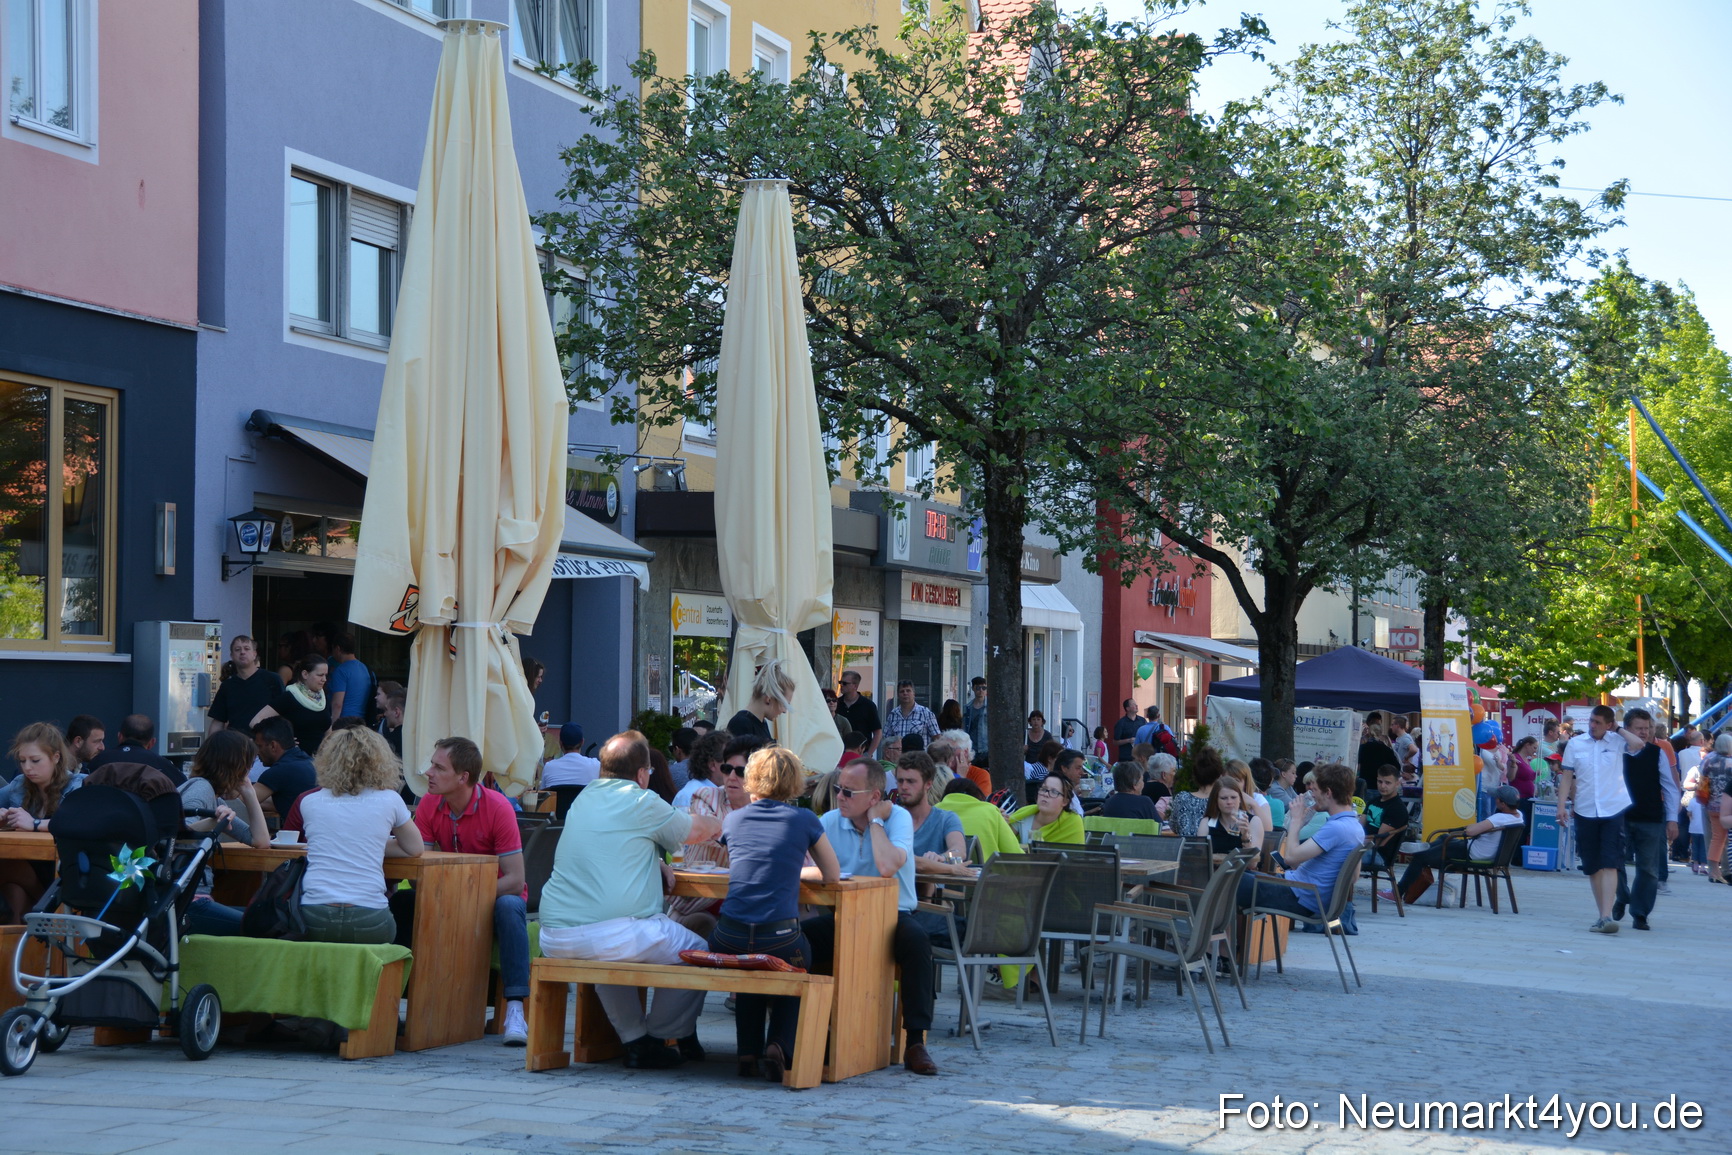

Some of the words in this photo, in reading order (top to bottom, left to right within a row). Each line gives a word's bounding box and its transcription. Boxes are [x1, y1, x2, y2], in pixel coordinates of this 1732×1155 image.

[911, 582, 923, 602] KINO
[925, 584, 961, 607] GESCHLOSSEN
[677, 603, 702, 625] Central
